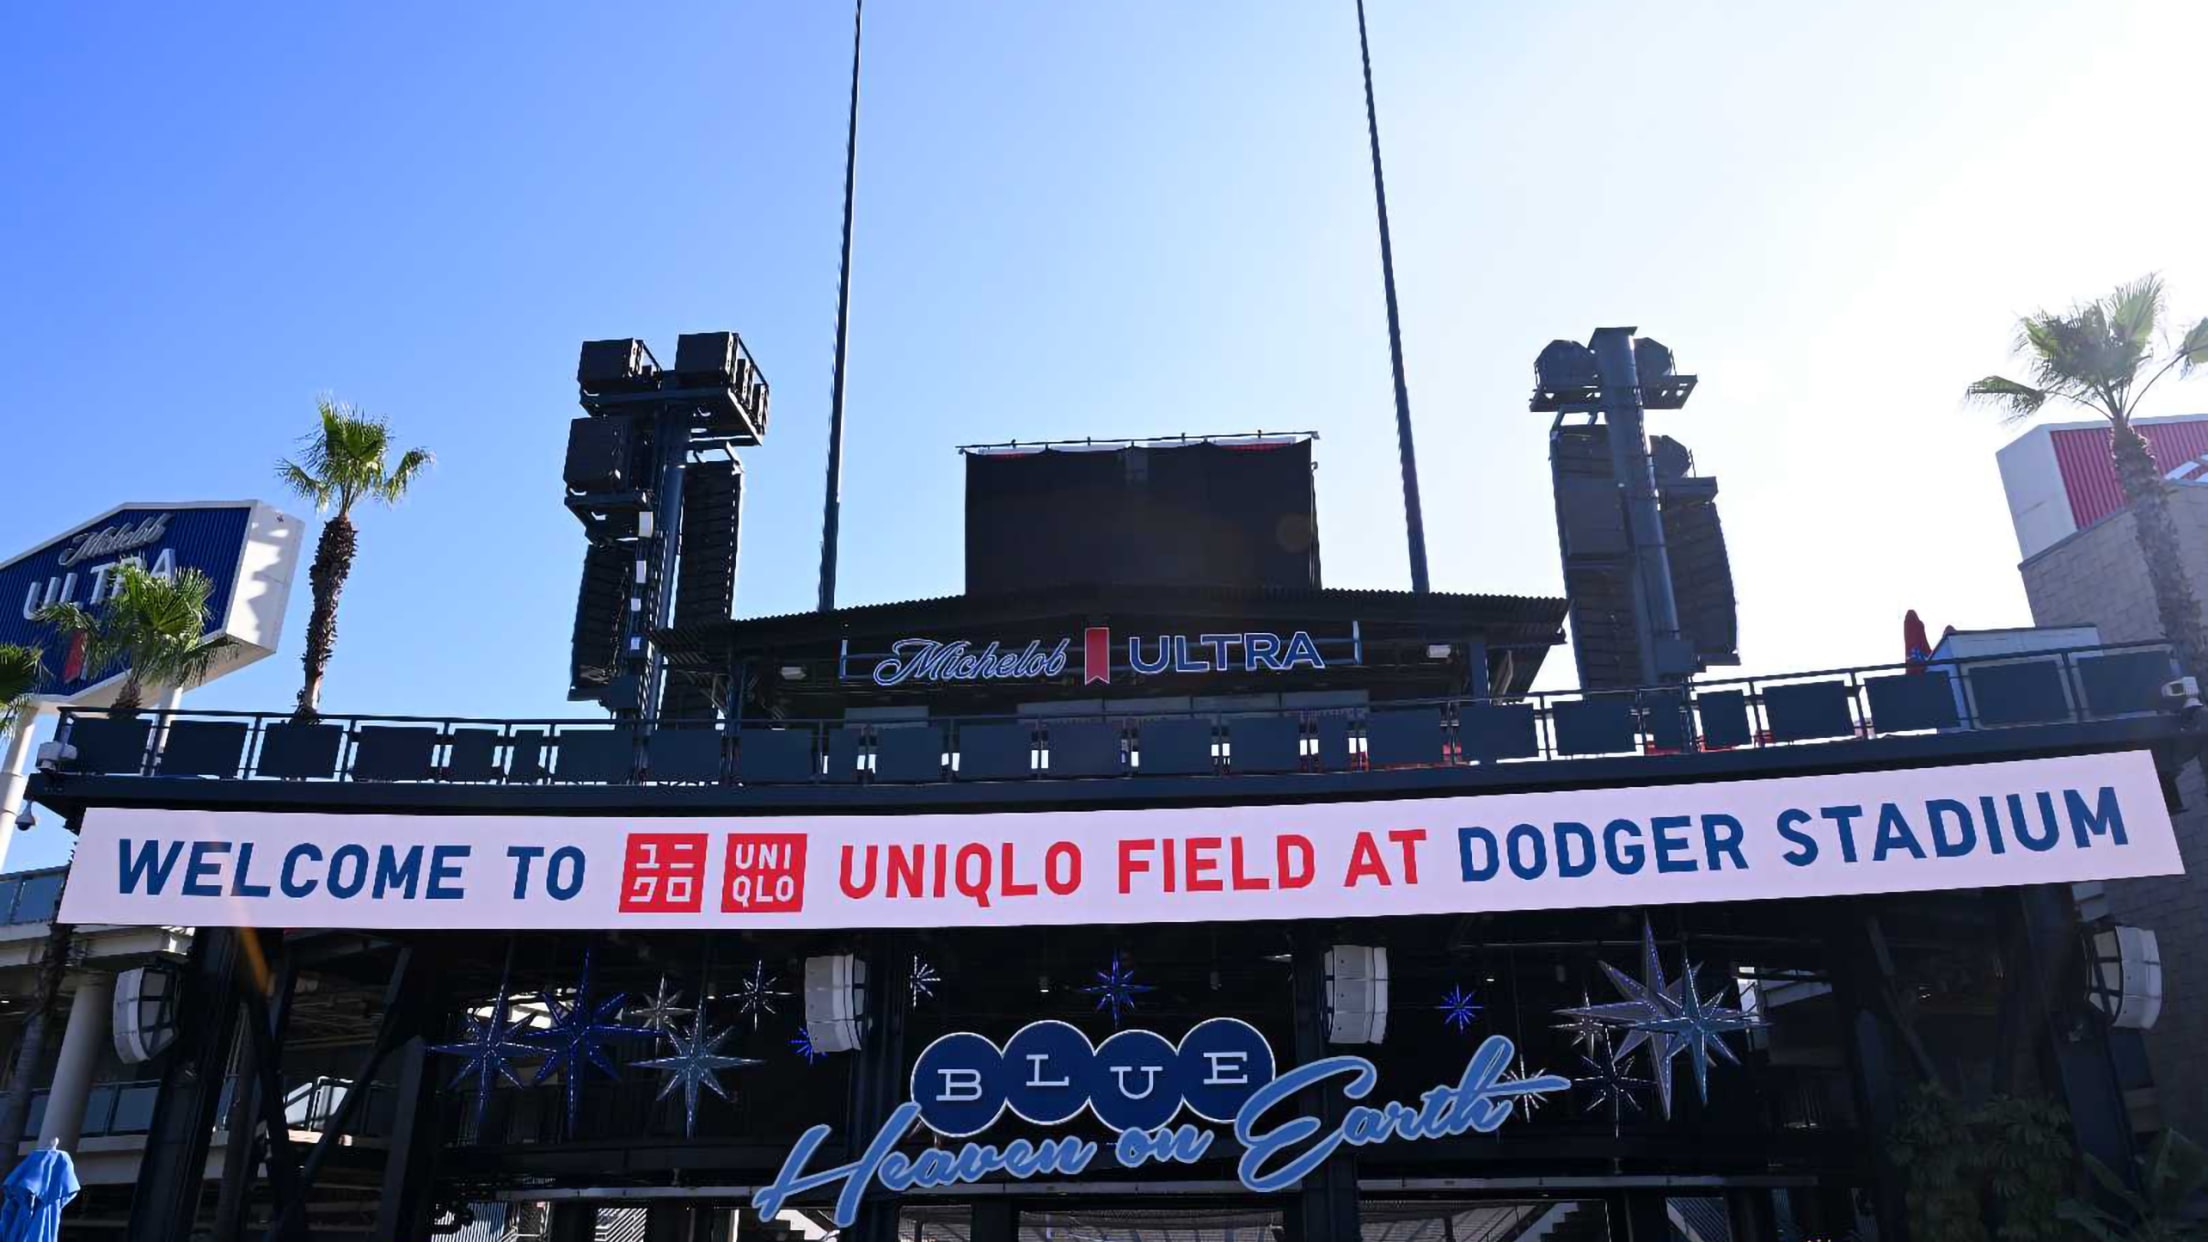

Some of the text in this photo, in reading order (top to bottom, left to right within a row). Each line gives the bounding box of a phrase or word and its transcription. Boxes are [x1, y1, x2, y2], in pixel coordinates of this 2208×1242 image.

[873, 630, 1326, 687] Michelob ULTRA
[118, 838, 586, 901] WELCOME TO
[735, 843, 792, 870] UNI
[839, 786, 2128, 909] UNIQLO FIELD AT DODGER STADIUM
[732, 875, 795, 908] QLO
[936, 1051, 1248, 1101] BLUE
[751, 1033, 1572, 1229] Heaven on Earth
